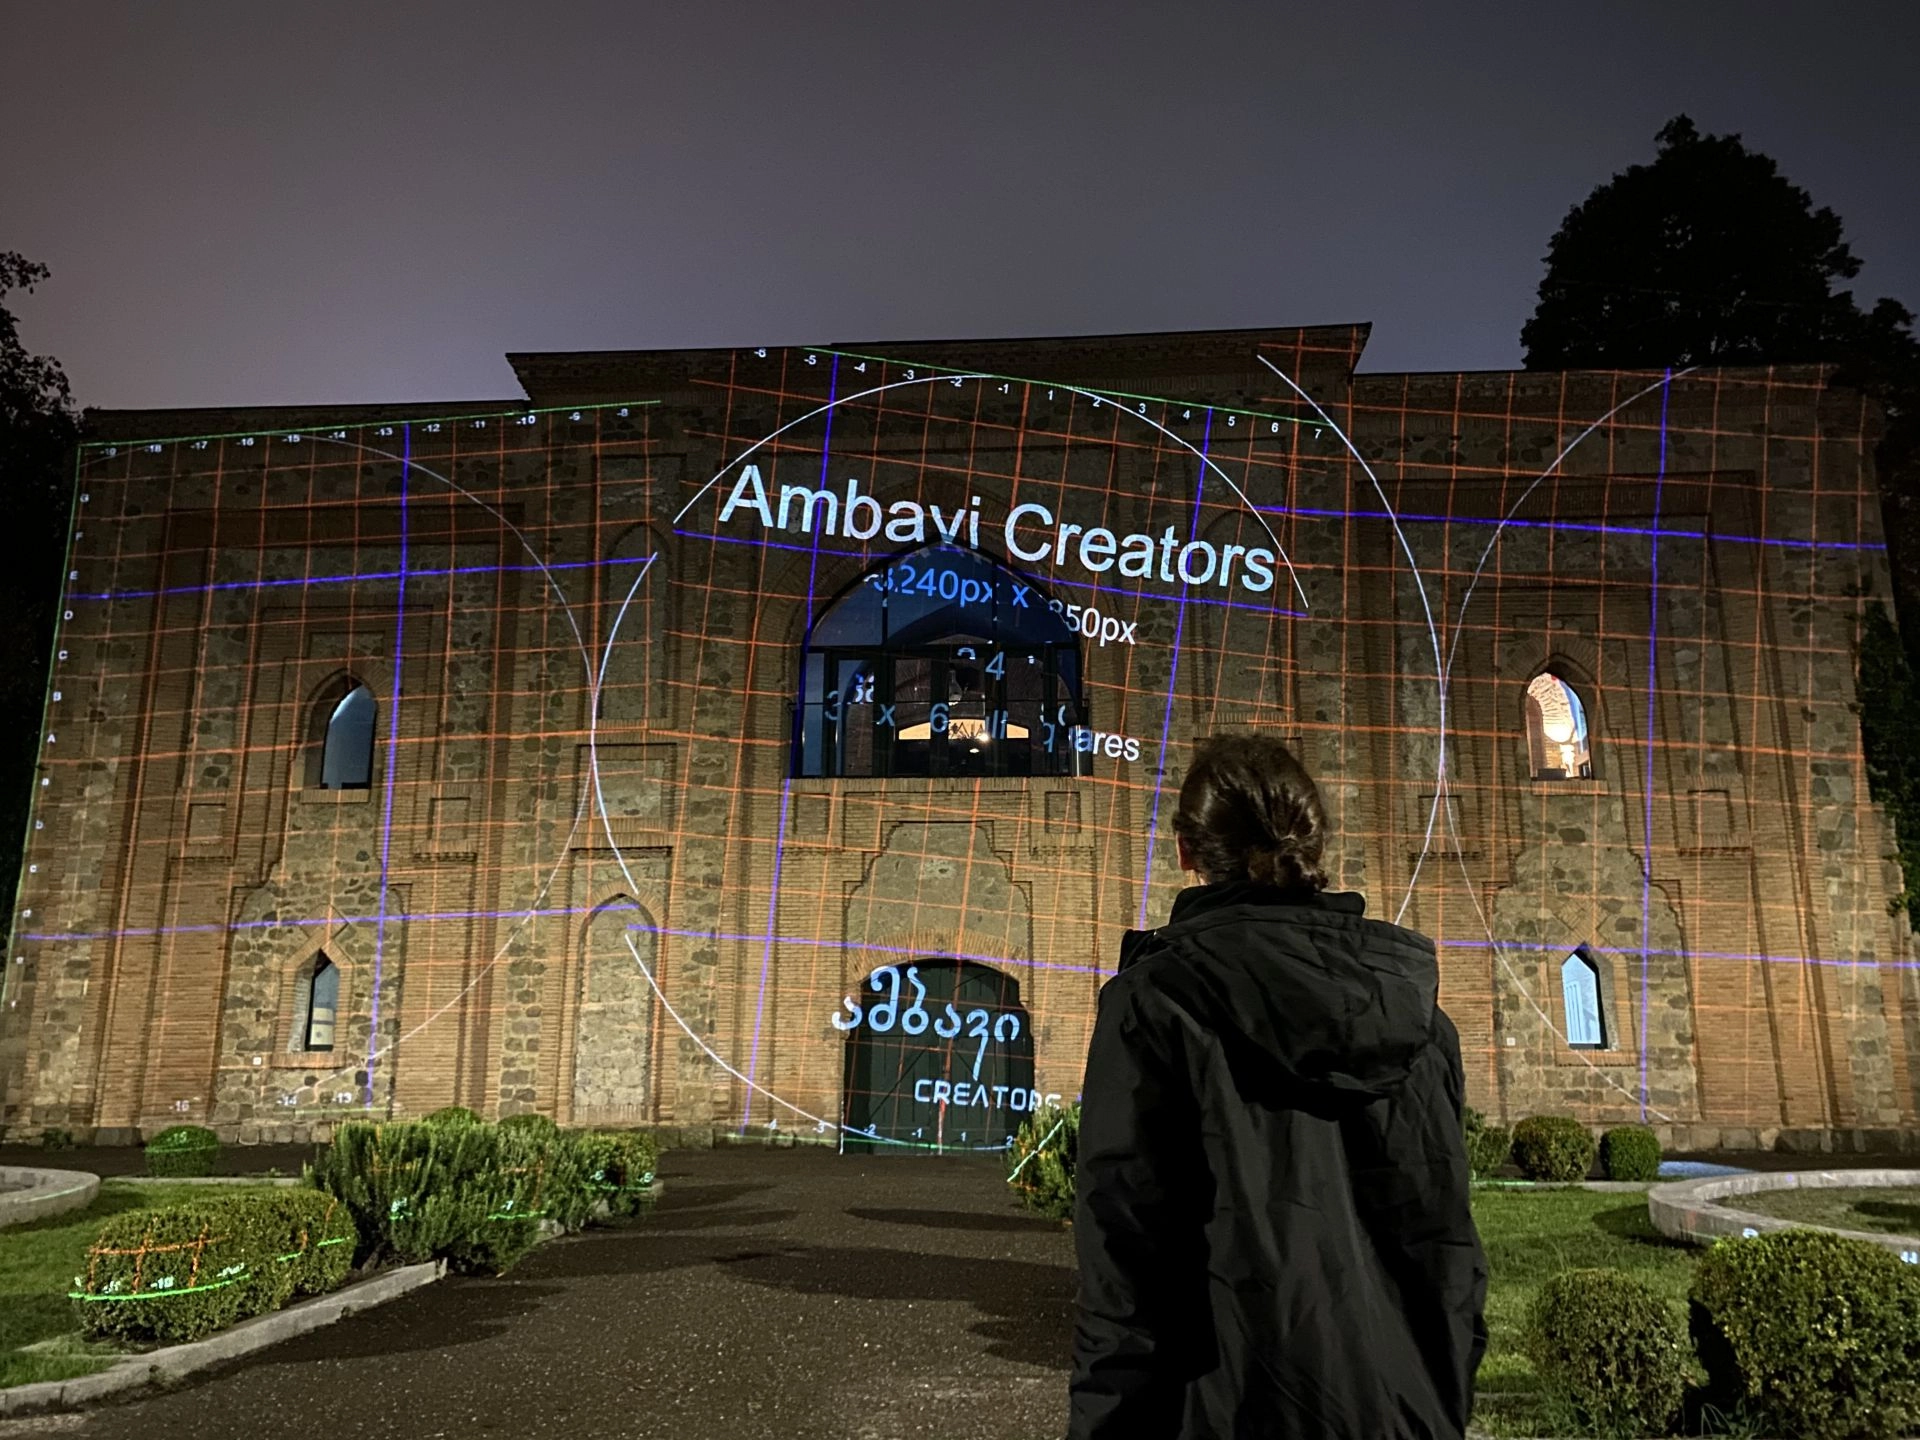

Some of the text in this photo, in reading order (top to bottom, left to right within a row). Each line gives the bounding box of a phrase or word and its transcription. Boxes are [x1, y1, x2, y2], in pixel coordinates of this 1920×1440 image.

[803, 354, 817, 365] -5
[853, 362, 867, 373] -4
[902, 369, 915, 380] -3
[949, 376, 963, 388] -2
[997, 384, 1009, 394] -1
[1047, 389, 1055, 401] 1
[1092, 396, 1102, 408] 2
[1137, 402, 1147, 414] 3
[1181, 409, 1191, 420] 4
[1227, 415, 1236, 427] 5
[1270, 422, 1279, 434] 6
[1313, 428, 1322, 439] 7
[190, 440, 209, 449] -17
[236, 437, 254, 447] -16
[282, 434, 301, 443] -15
[328, 431, 346, 440] -14
[374, 427, 393, 437] -13
[421, 423, 440, 432] -12
[470, 420, 486, 429] -11
[516, 415, 536, 425] -10
[718, 463, 1276, 592] Ambavi Creators
[69, 570, 79, 580] E
[46, 733, 56, 743] A
[831, 965, 1021, 1081] ამბავი
[914, 1079, 1061, 1112] CREATORS
[911, 1127, 923, 1138] -1
